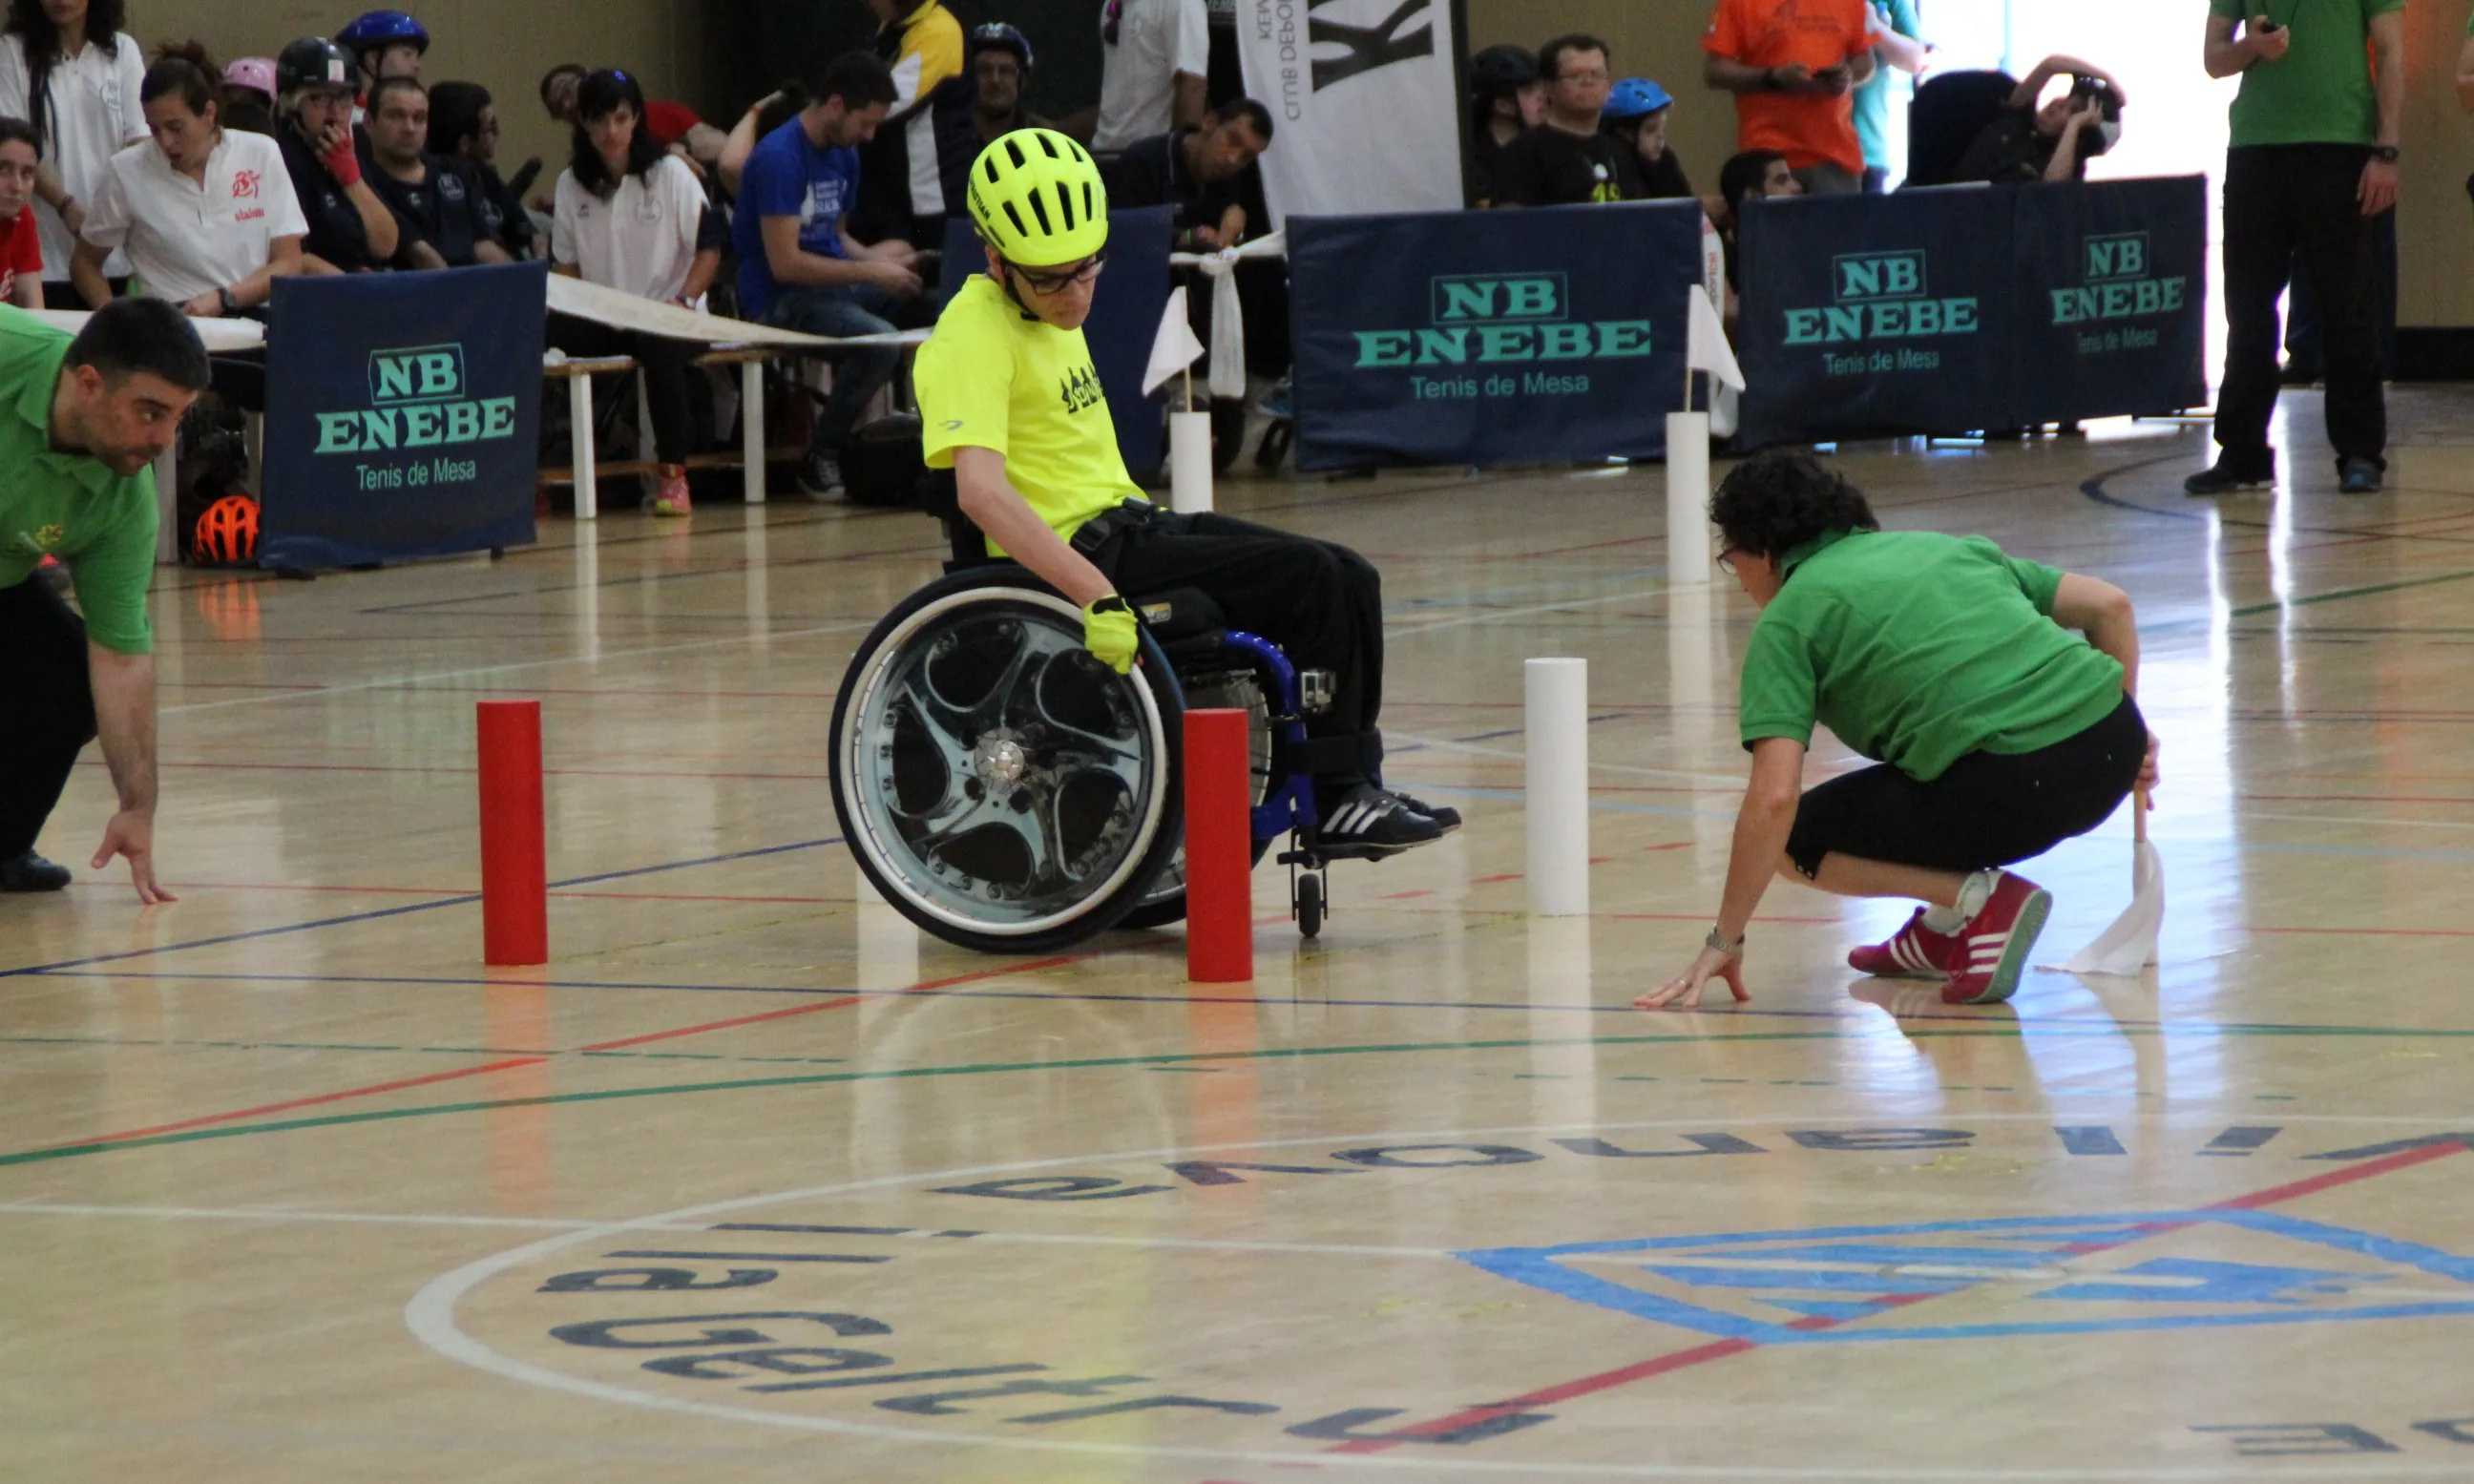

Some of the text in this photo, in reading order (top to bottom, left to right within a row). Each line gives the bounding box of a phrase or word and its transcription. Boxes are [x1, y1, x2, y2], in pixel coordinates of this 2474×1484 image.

[1840, 257, 1918, 297] NB
[2087, 239, 2143, 277] NB
[1441, 280, 1557, 318] NB
[2051, 275, 2187, 324] ENEBE
[1782, 297, 1979, 345] ENEBE
[1353, 319, 1650, 368] ENEBE
[1822, 346, 1940, 375] Tenis de Mesa
[377, 352, 457, 398] NB
[1410, 371, 1590, 399] Tenis de Mesa
[313, 396, 515, 453] ENEBE
[356, 457, 476, 490] Tenis de Mesa
